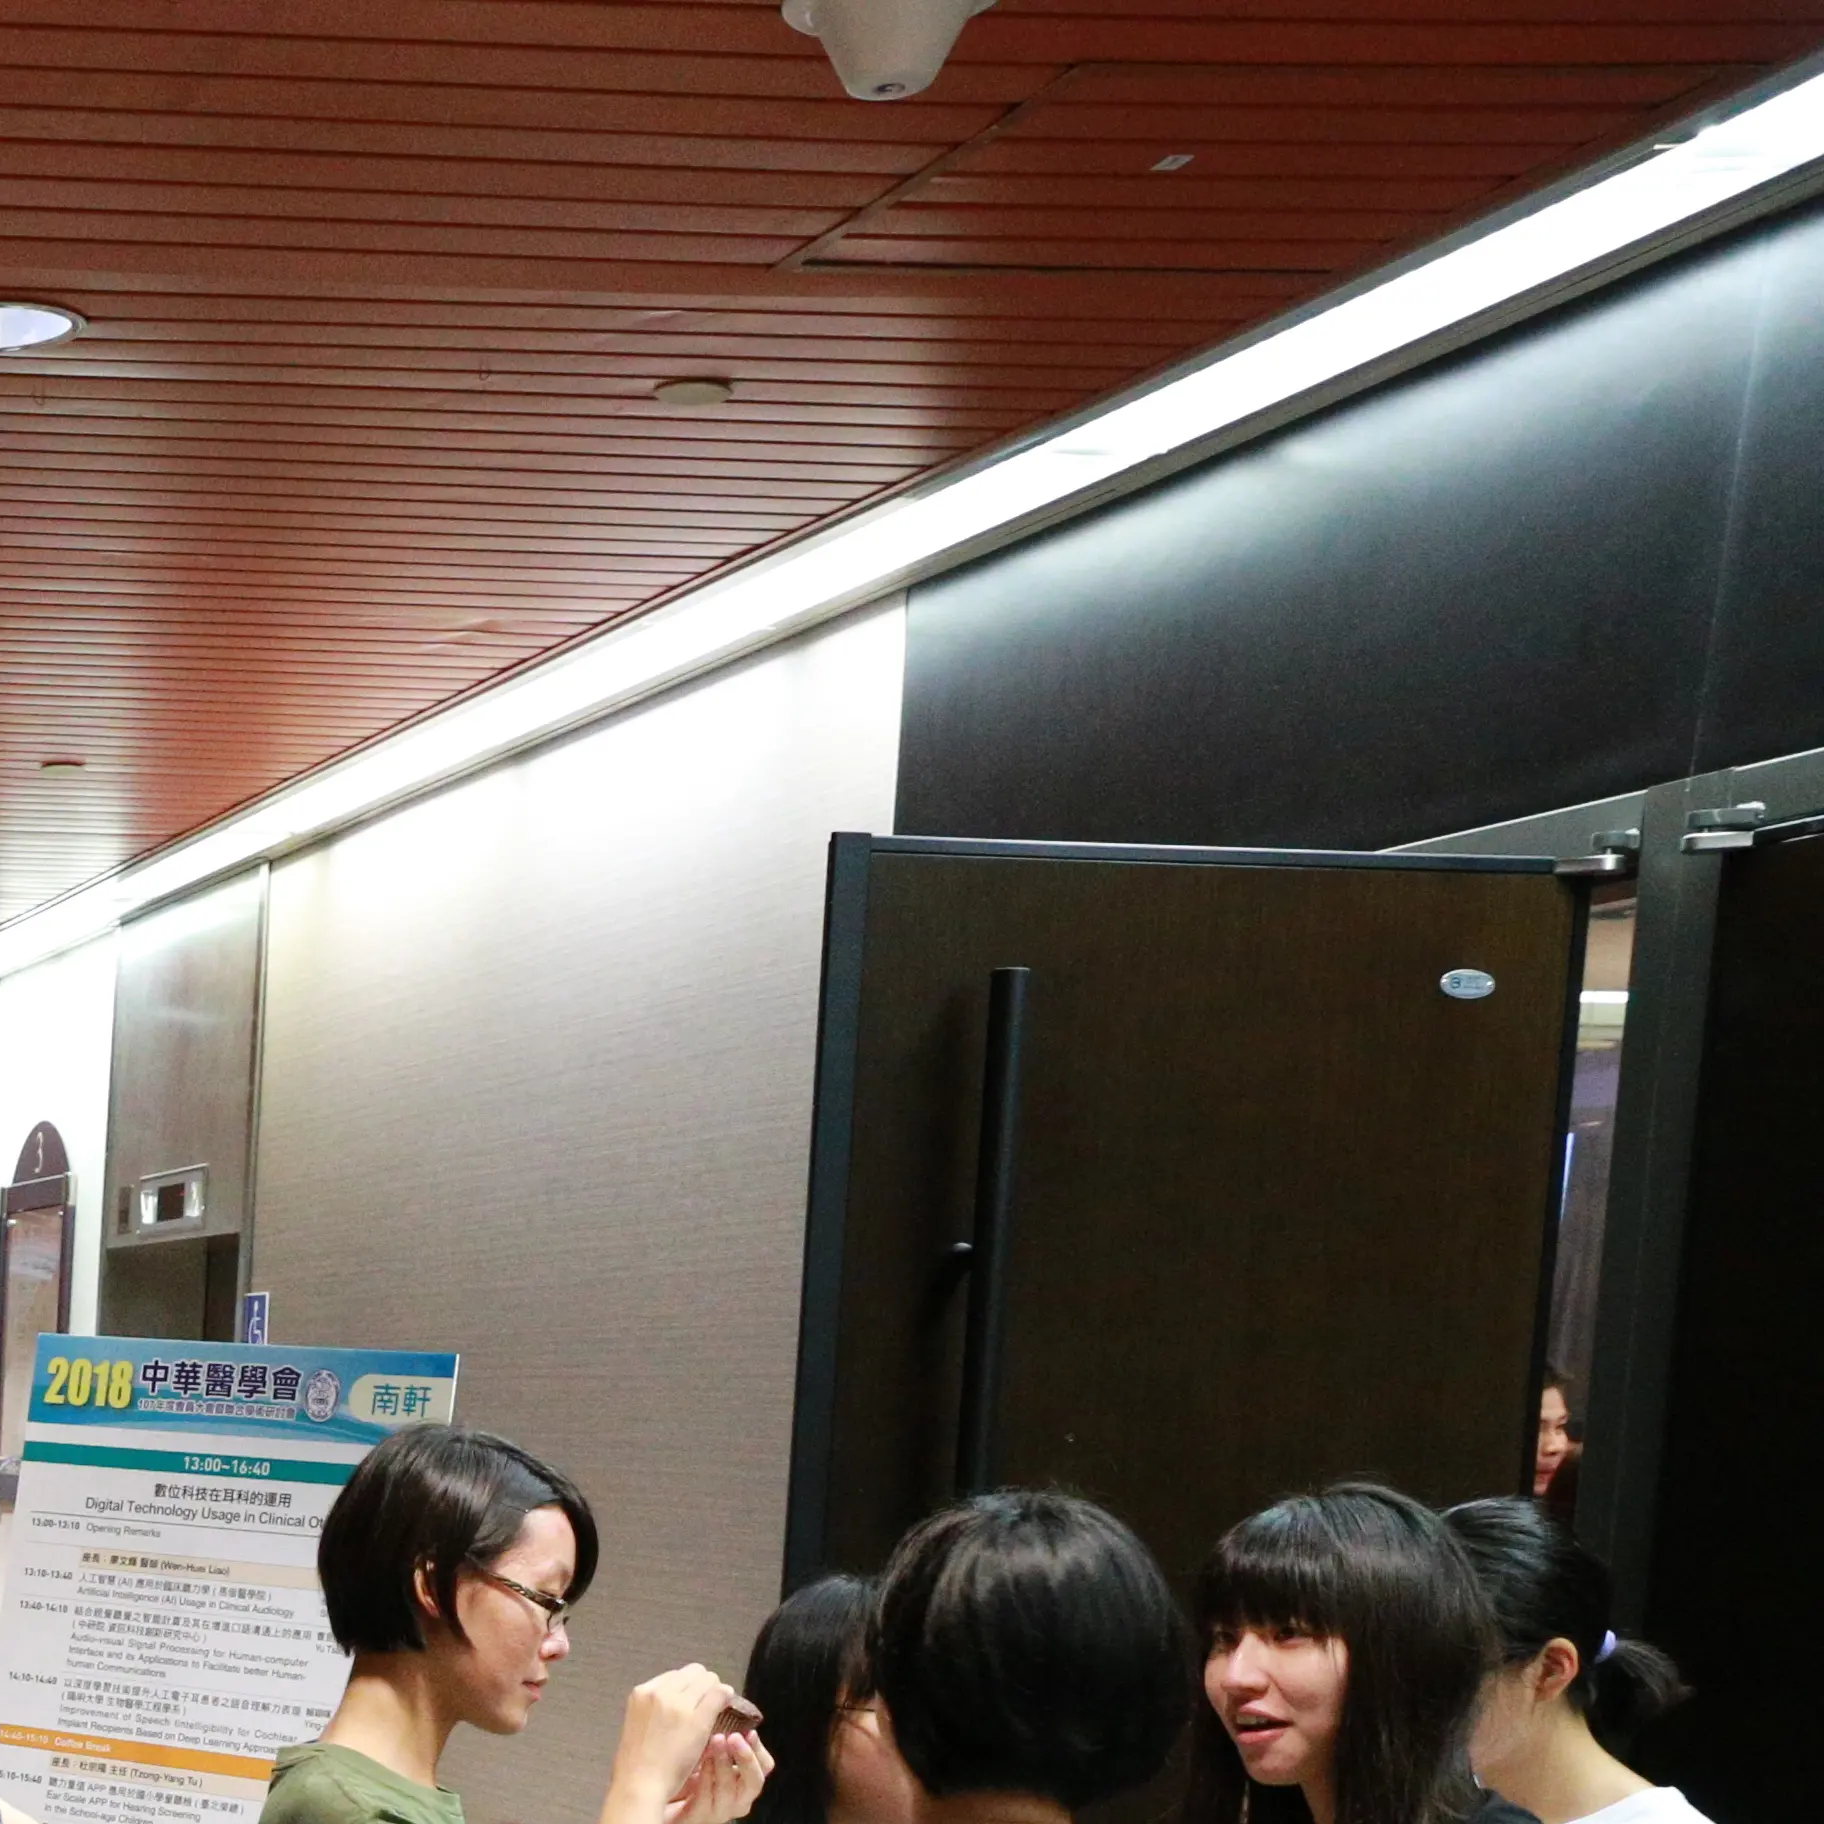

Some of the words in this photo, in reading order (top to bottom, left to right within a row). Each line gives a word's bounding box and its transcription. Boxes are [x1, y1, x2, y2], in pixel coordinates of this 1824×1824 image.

[43, 1356, 134, 1409] 2018
[140, 1359, 301, 1402] 中華醫學會
[369, 1383, 432, 1418] 南軒
[154, 1483, 291, 1507] 數位科技在耳科的運用
[85, 1497, 123, 1513] Digital
[127, 1500, 197, 1520] Technology
[201, 1506, 240, 1523] Usage
[244, 1510, 255, 1522] in
[258, 1511, 305, 1526] Clinical
[86, 1523, 120, 1535] Opening
[123, 1526, 160, 1537] Remarks
[77, 1586, 109, 1597] Artificial
[112, 1590, 158, 1604] Intelligence
[179, 1597, 205, 1608] Usage
[219, 1601, 250, 1611] Clinical
[252, 1604, 295, 1618] Audiology
[69, 1645, 103, 1657] Interface
[107, 1650, 122, 1659] and
[137, 1653, 188, 1668] Applications
[244, 1666, 269, 1676] better
[71, 1632, 124, 1646] Audio-visual
[128, 1639, 155, 1651] Signal
[159, 1642, 209, 1657] Processing
[212, 1648, 224, 1657] for
[229, 1650, 308, 1669] Human-computer
[66, 1658, 94, 1669] human
[97, 1662, 166, 1677] Communications
[57, 1716, 87, 1729] Implant
[90, 1721, 133, 1735] Recipients
[136, 1727, 162, 1737] Based
[165, 1730, 175, 1739] on
[177, 1732, 200, 1744] Deep
[202, 1735, 241, 1749] Learning
[59, 1703, 119, 1720] Improvement
[122, 1712, 131, 1720] of
[135, 1713, 170, 1726] Speech
[237, 1726, 250, 1735] for
[254, 1728, 297, 1741] Cochlear
[87, 1782, 106, 1793] APP
[46, 1790, 60, 1800] Ear
[63, 1792, 86, 1804] Scale
[88, 1796, 107, 1807] APP
[109, 1799, 120, 1808] for
[122, 1801, 155, 1815] Hearing
[158, 1806, 200, 1822] Screening
[54, 1804, 67, 1813] the
[69, 1806, 115, 1822] School-age
